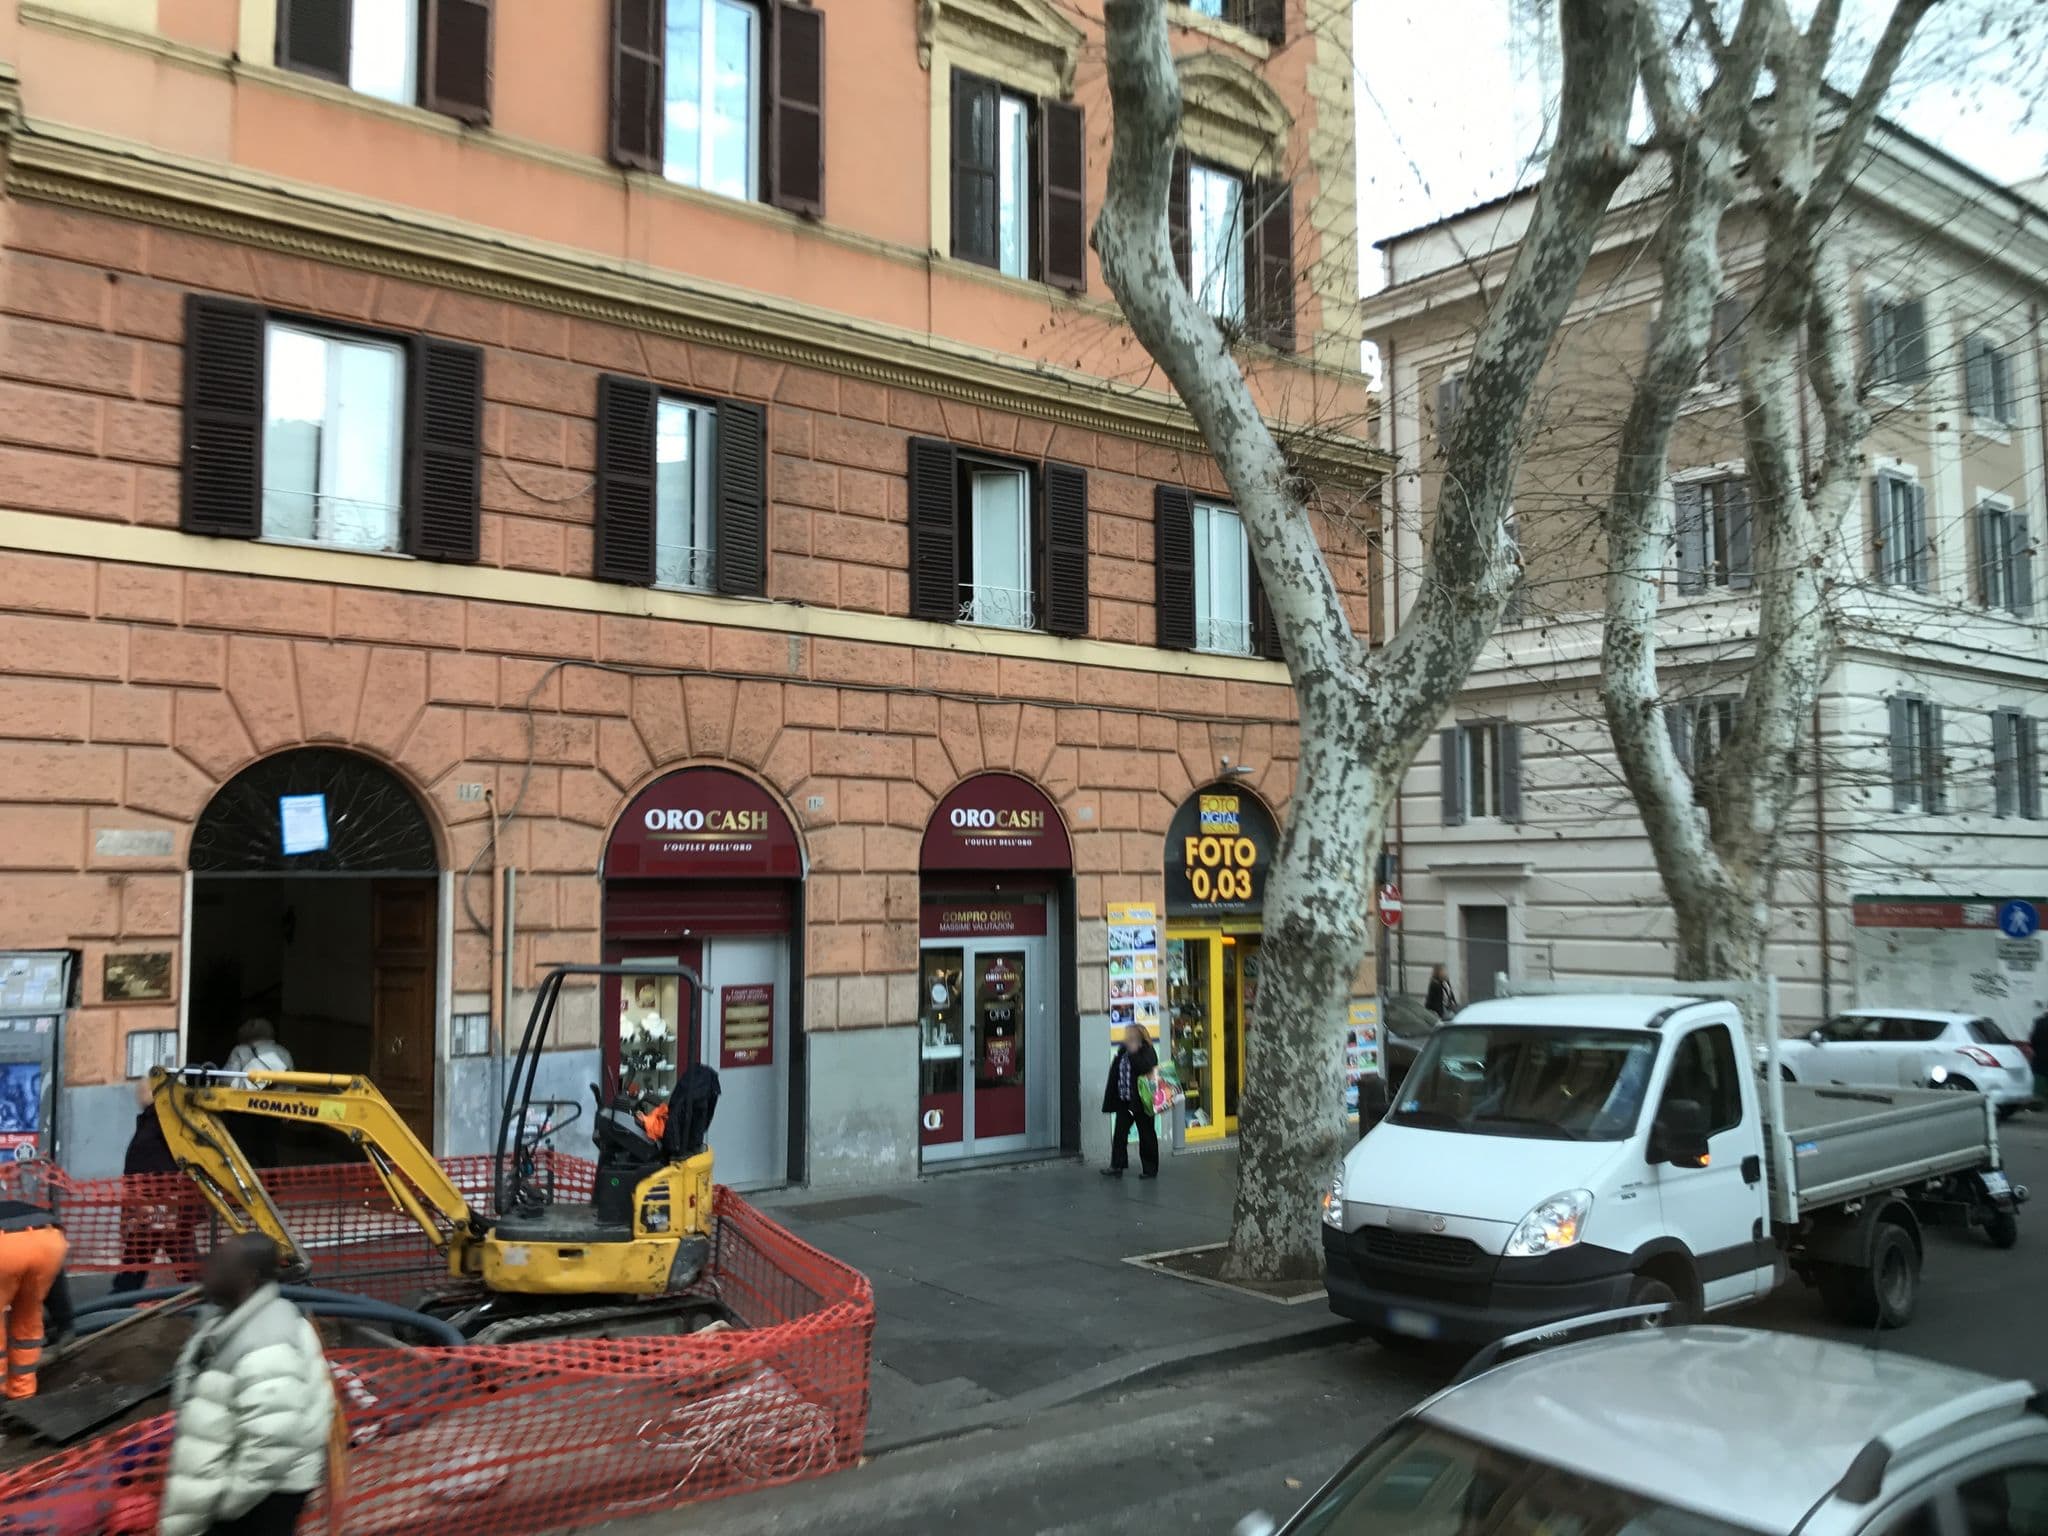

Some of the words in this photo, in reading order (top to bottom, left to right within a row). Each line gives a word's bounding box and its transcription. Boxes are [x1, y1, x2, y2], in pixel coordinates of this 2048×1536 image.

[644, 808, 768, 830] OROCASH
[950, 808, 1044, 828] OROCASH
[663, 843, 705, 852] L'OUTLET
[708, 843, 752, 852] DELL'ORO
[964, 838, 996, 846] L'OUTLET
[999, 838, 1032, 847] DELL'ORO
[1185, 836, 1257, 867] FOTO
[1192, 868, 1252, 902] 0,03
[942, 911, 988, 922] COMPRO
[990, 910, 1012, 921] ORO
[248, 1097, 319, 1117] KOMATSU
